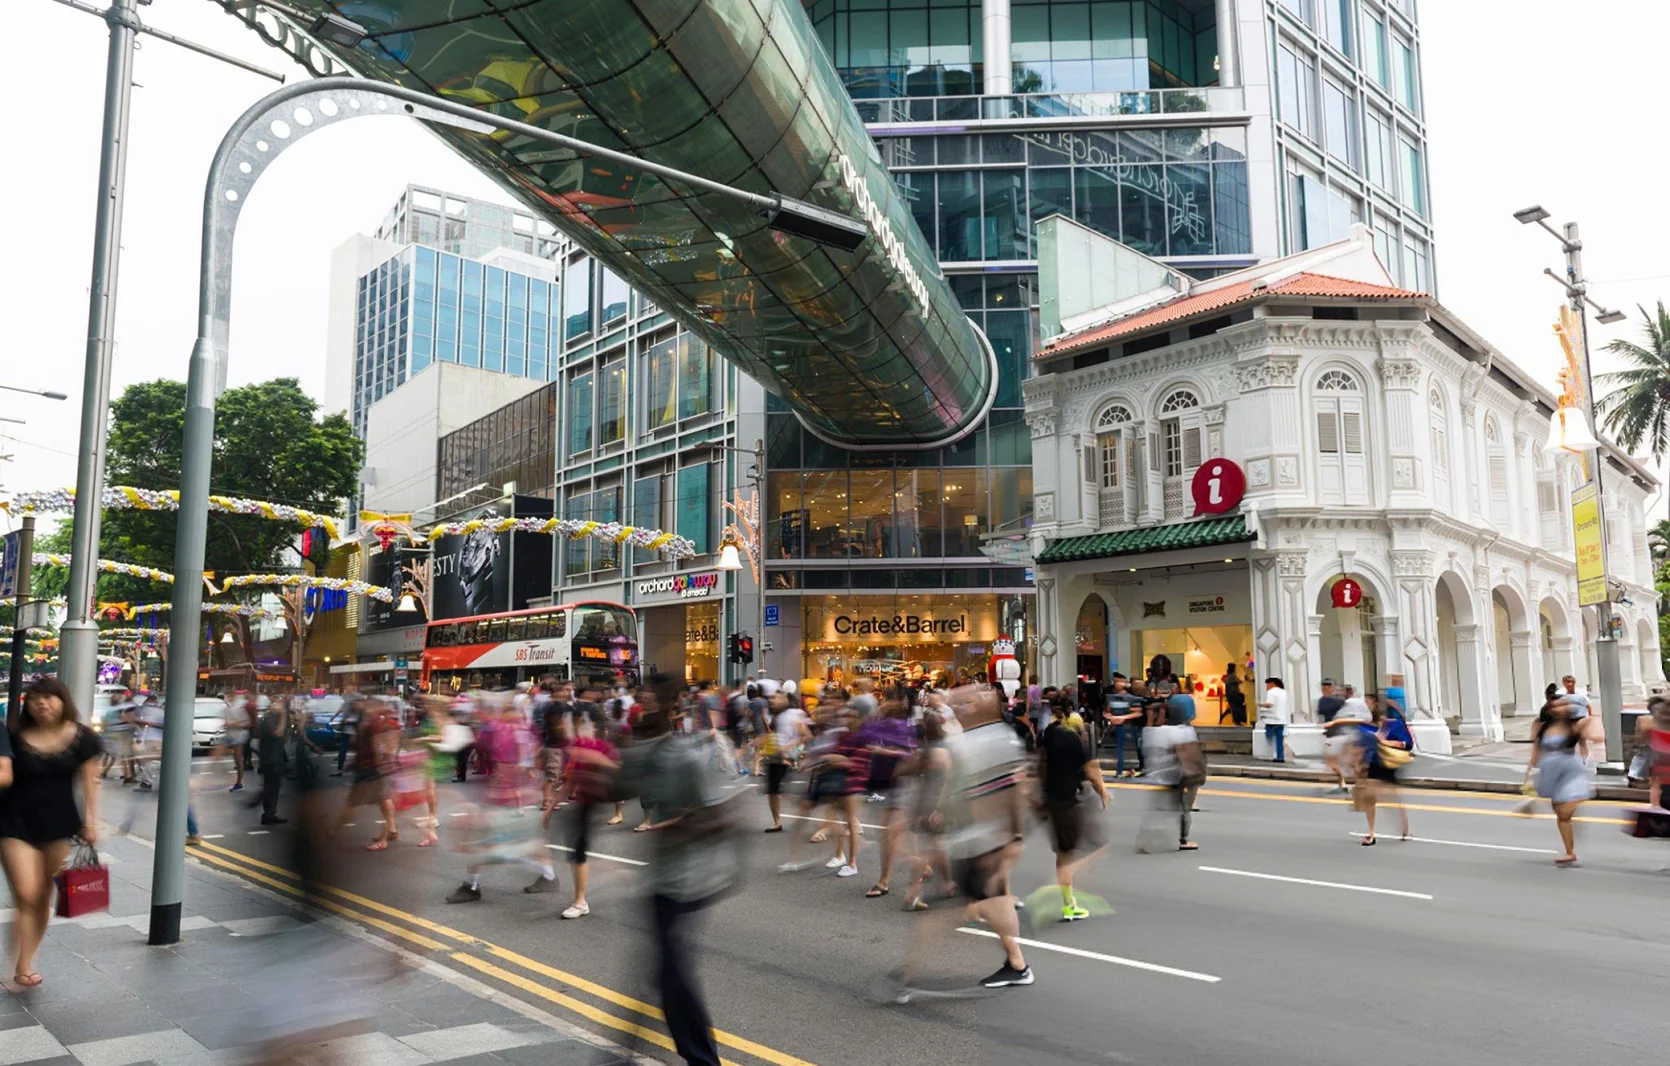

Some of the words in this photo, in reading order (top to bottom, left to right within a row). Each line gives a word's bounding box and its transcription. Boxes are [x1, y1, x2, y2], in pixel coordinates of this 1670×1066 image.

[639, 574, 717, 595] orchardgateway
[834, 615, 965, 634] Crate&Barrel
[515, 648, 527, 661] SBS
[528, 644, 556, 660] Transit
